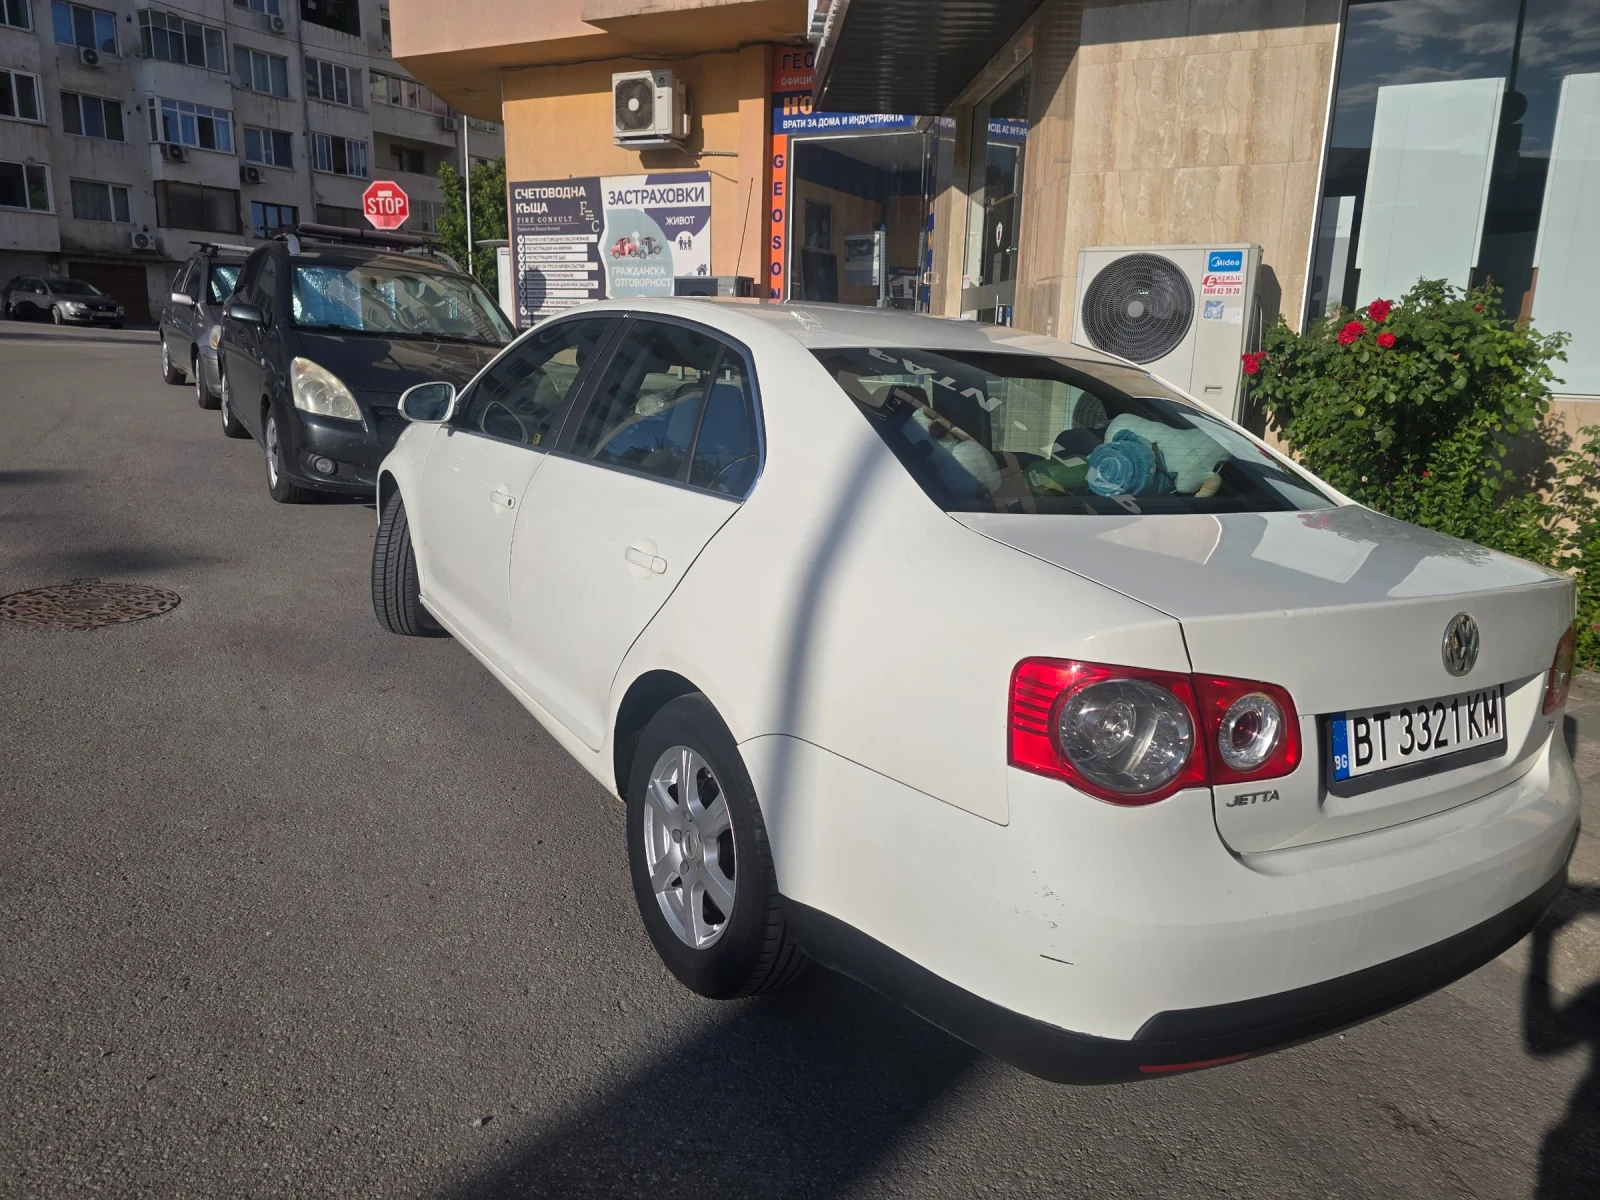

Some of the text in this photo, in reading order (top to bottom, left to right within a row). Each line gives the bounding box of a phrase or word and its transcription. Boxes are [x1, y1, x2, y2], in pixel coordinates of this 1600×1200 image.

[783, 114, 904, 129] ВРАТИ ЗА ДОМА И ИНДУСТРИЯТА
[514, 186, 586, 200] СЧЕТОВОДНА
[608, 186, 705, 206] ЗАСТРАХОВКИ
[367, 197, 404, 214] STOP
[515, 202, 548, 214] КЪЩА
[665, 215, 695, 226] ЖИВОТ
[771, 154, 784, 299] GEOSON
[1212, 258, 1240, 267] Midea
[611, 266, 666, 277] ГРАЖДАНСКА
[615, 278, 672, 287] ОТГОВОРНОСТ
[1335, 689, 1498, 770] BG BT 3321 KM
[1225, 789, 1280, 807] JETTA
